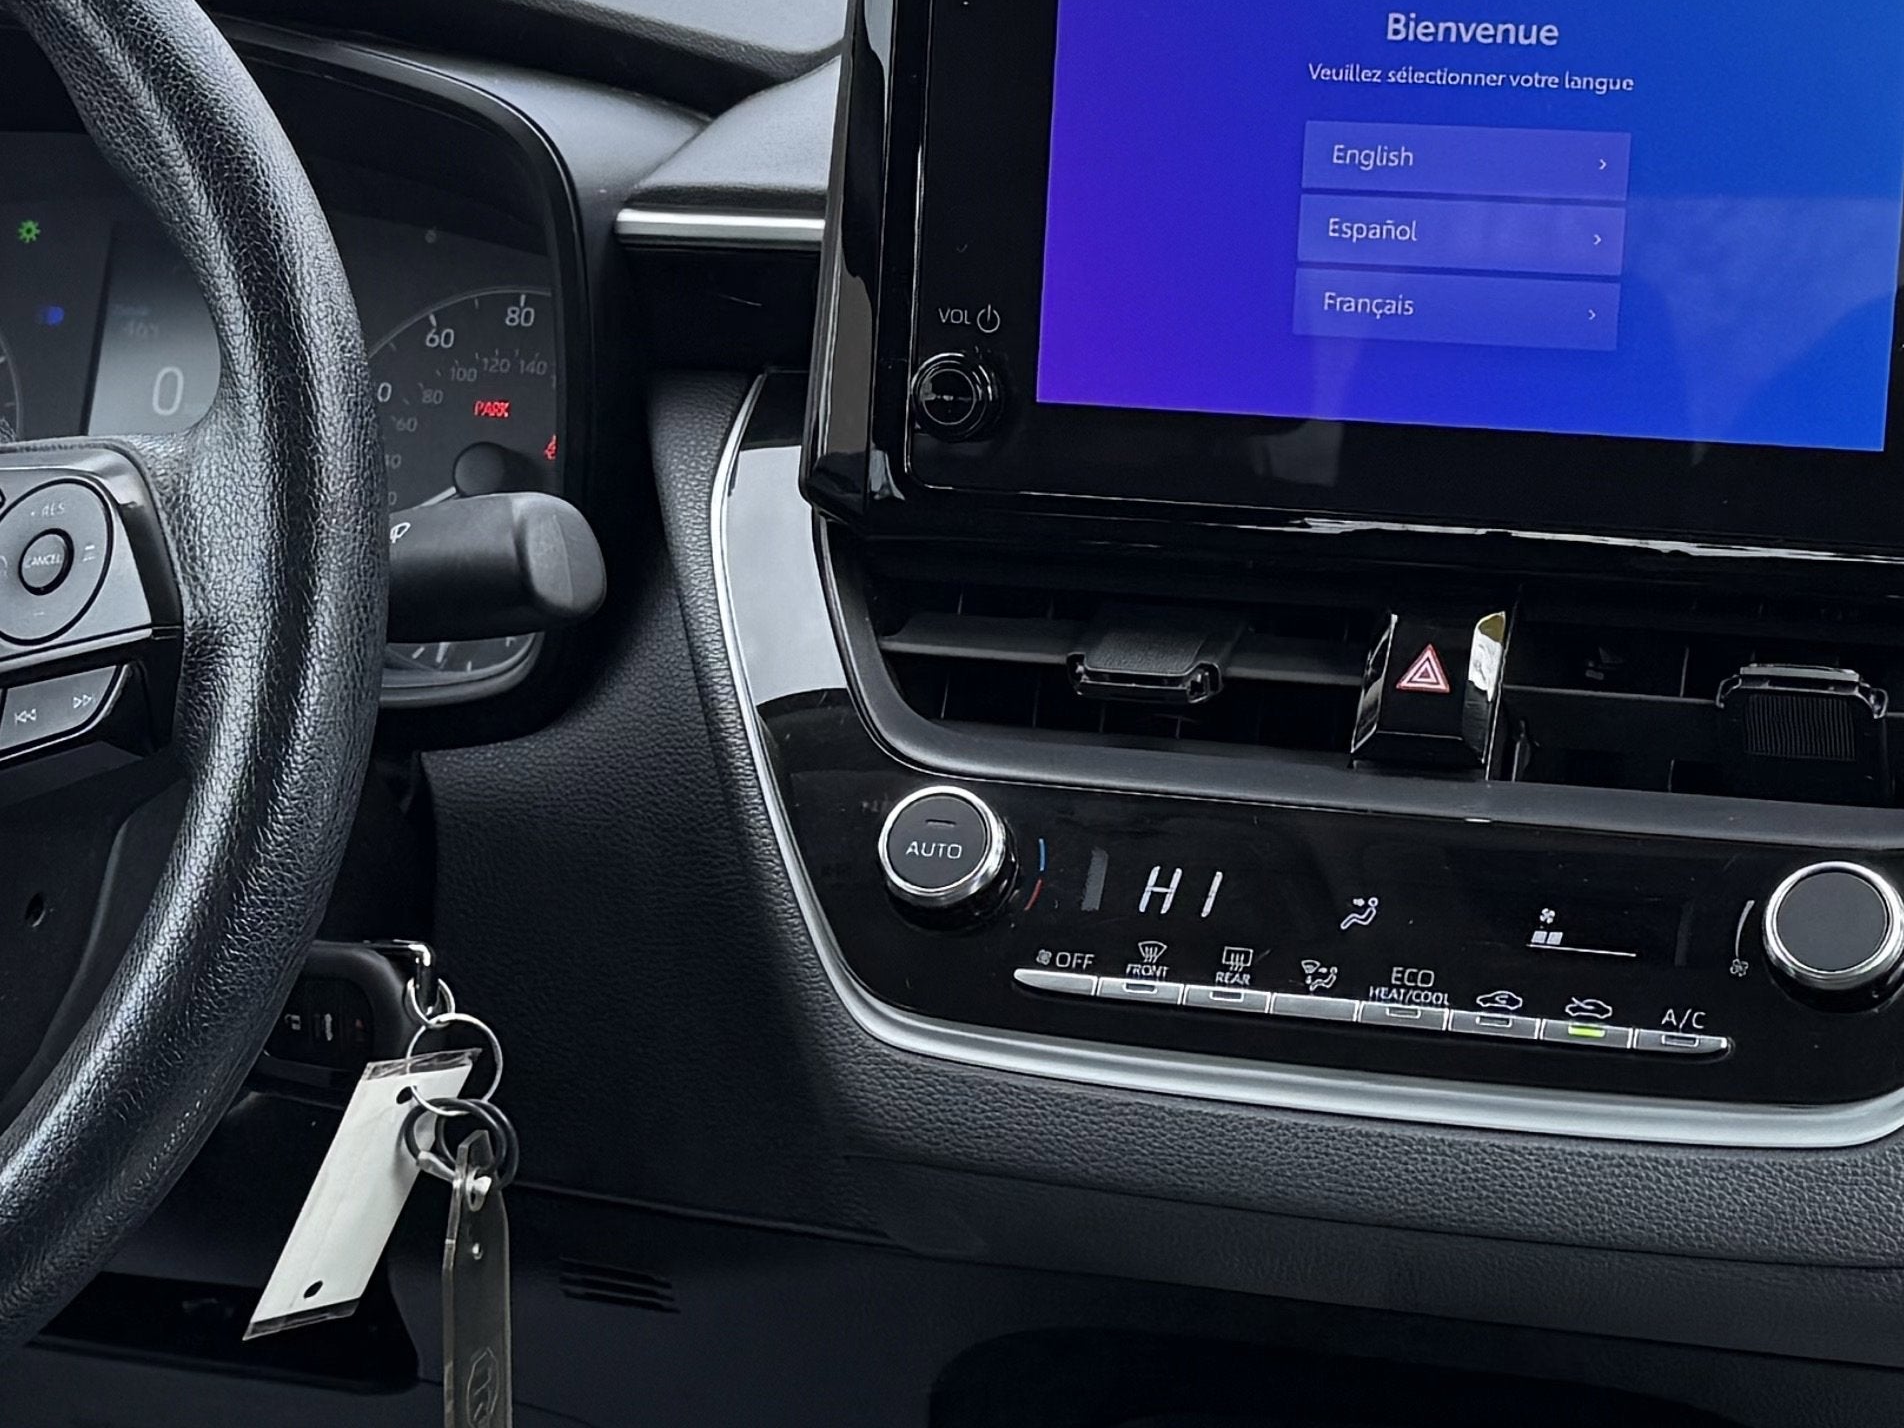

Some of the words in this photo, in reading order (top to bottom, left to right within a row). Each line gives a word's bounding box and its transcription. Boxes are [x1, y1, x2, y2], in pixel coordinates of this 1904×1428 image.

[1386, 12, 1559, 46] Bienvenue
[1308, 63, 1382, 83] Veuillez
[1387, 65, 1507, 86] sélectionner
[1509, 72, 1559, 89] votre
[1564, 71, 1634, 95] langue
[1332, 144, 1414, 171] English
[1328, 217, 1417, 244] Español
[938, 307, 972, 325] VOL
[1323, 291, 1415, 320] Français
[504, 306, 536, 328] 80
[425, 328, 455, 349] 60
[449, 366, 478, 383] 100
[482, 358, 511, 374] 120
[519, 359, 547, 376] 140
[152, 366, 184, 416] 0
[377, 381, 393, 403] 0
[421, 389, 444, 405] 80
[474, 400, 510, 418] PARK
[905, 840, 963, 860] AUTO
[1138, 864, 1224, 918] HI
[1055, 951, 1095, 970] OFF
[1126, 963, 1170, 979] FRONT
[1215, 971, 1251, 986] REAR
[1390, 967, 1435, 988] ECO
[1369, 986, 1450, 1006] HEAT/COOL
[1661, 1008, 1706, 1030] A/C
